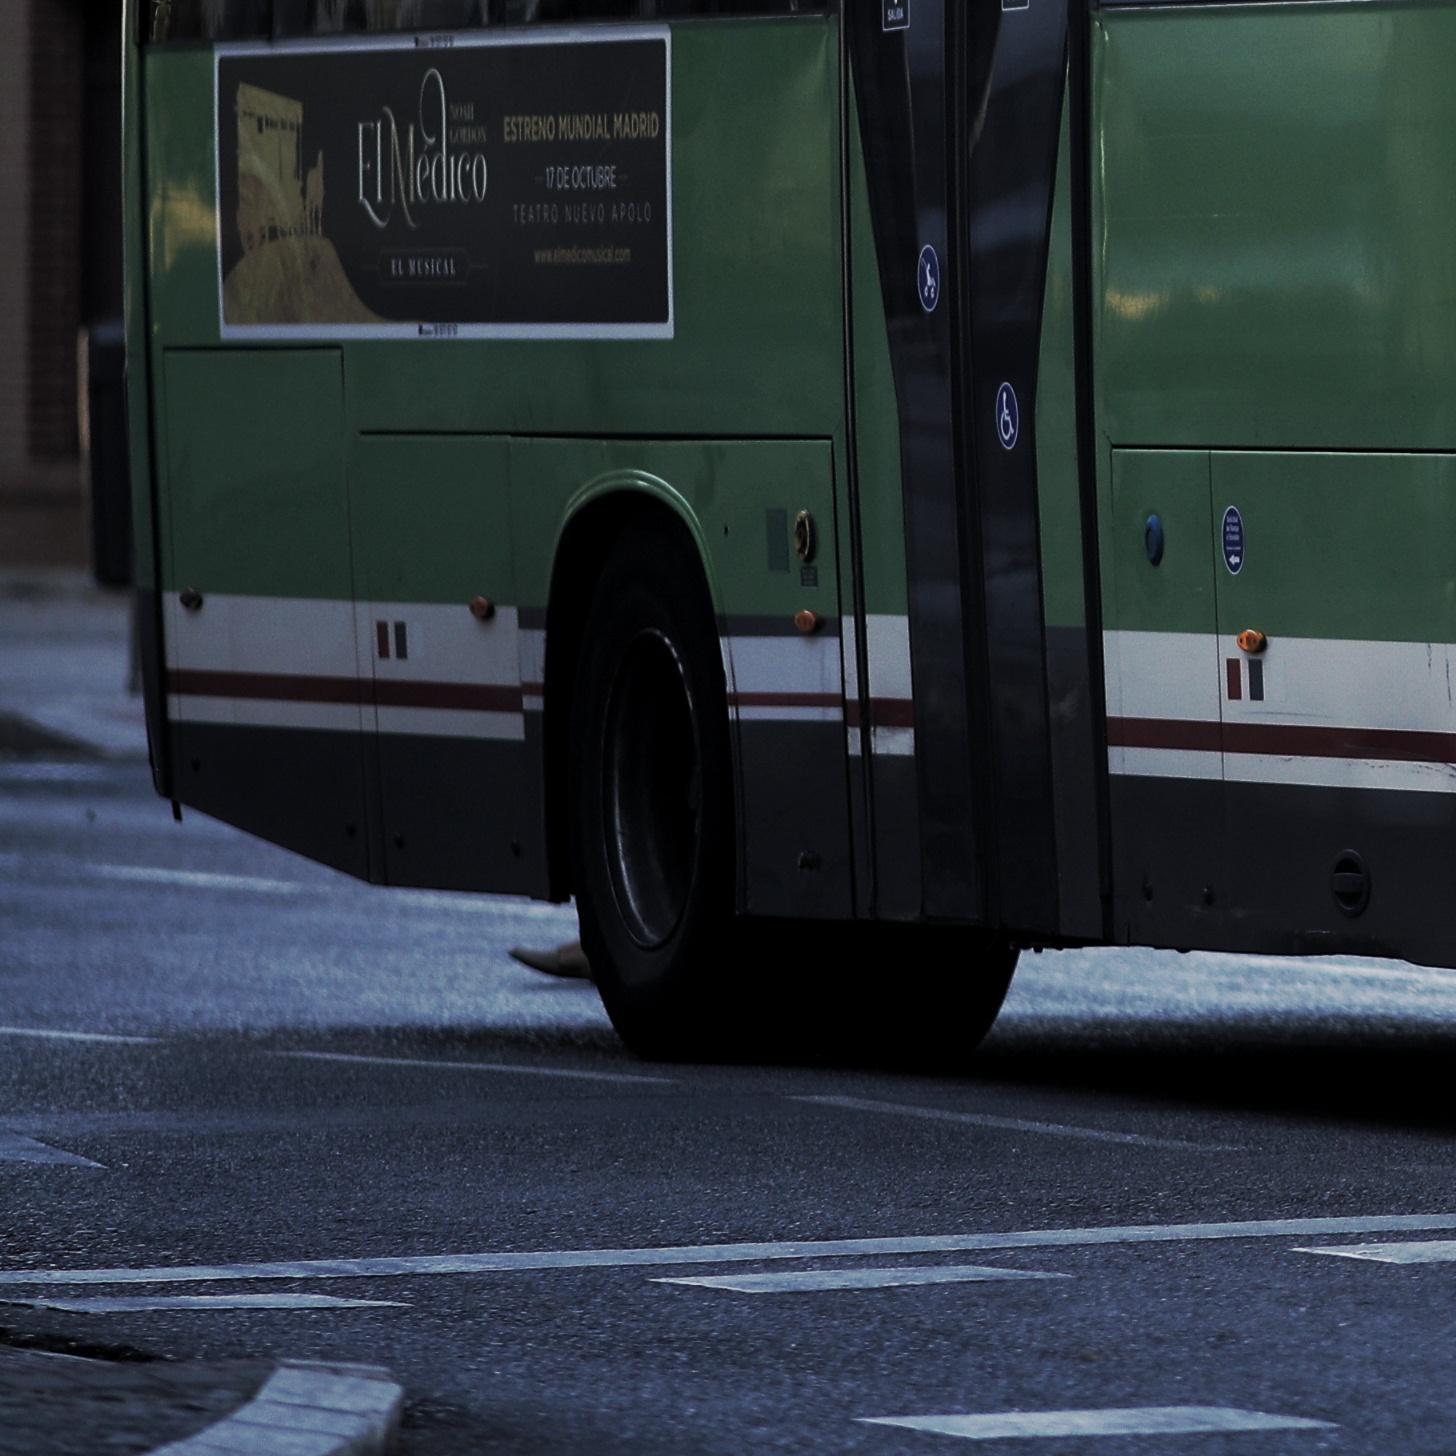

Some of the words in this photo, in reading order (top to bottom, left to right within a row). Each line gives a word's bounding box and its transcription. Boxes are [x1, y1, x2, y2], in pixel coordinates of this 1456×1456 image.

[887, 7, 904, 21] SALIDA
[503, 115, 556, 143] ESTRENO
[558, 113, 611, 141] MUNDIAL
[613, 112, 660, 140] MADRID
[545, 166, 555, 190] 17
[557, 166, 569, 190] DE
[571, 165, 617, 189] OCTUBRE
[513, 203, 559, 225] TEATRO
[565, 203, 605, 224] NUEVO
[611, 202, 652, 223] APOLO
[391, 258, 402, 276] EL
[408, 257, 457, 276] MUSICAL
